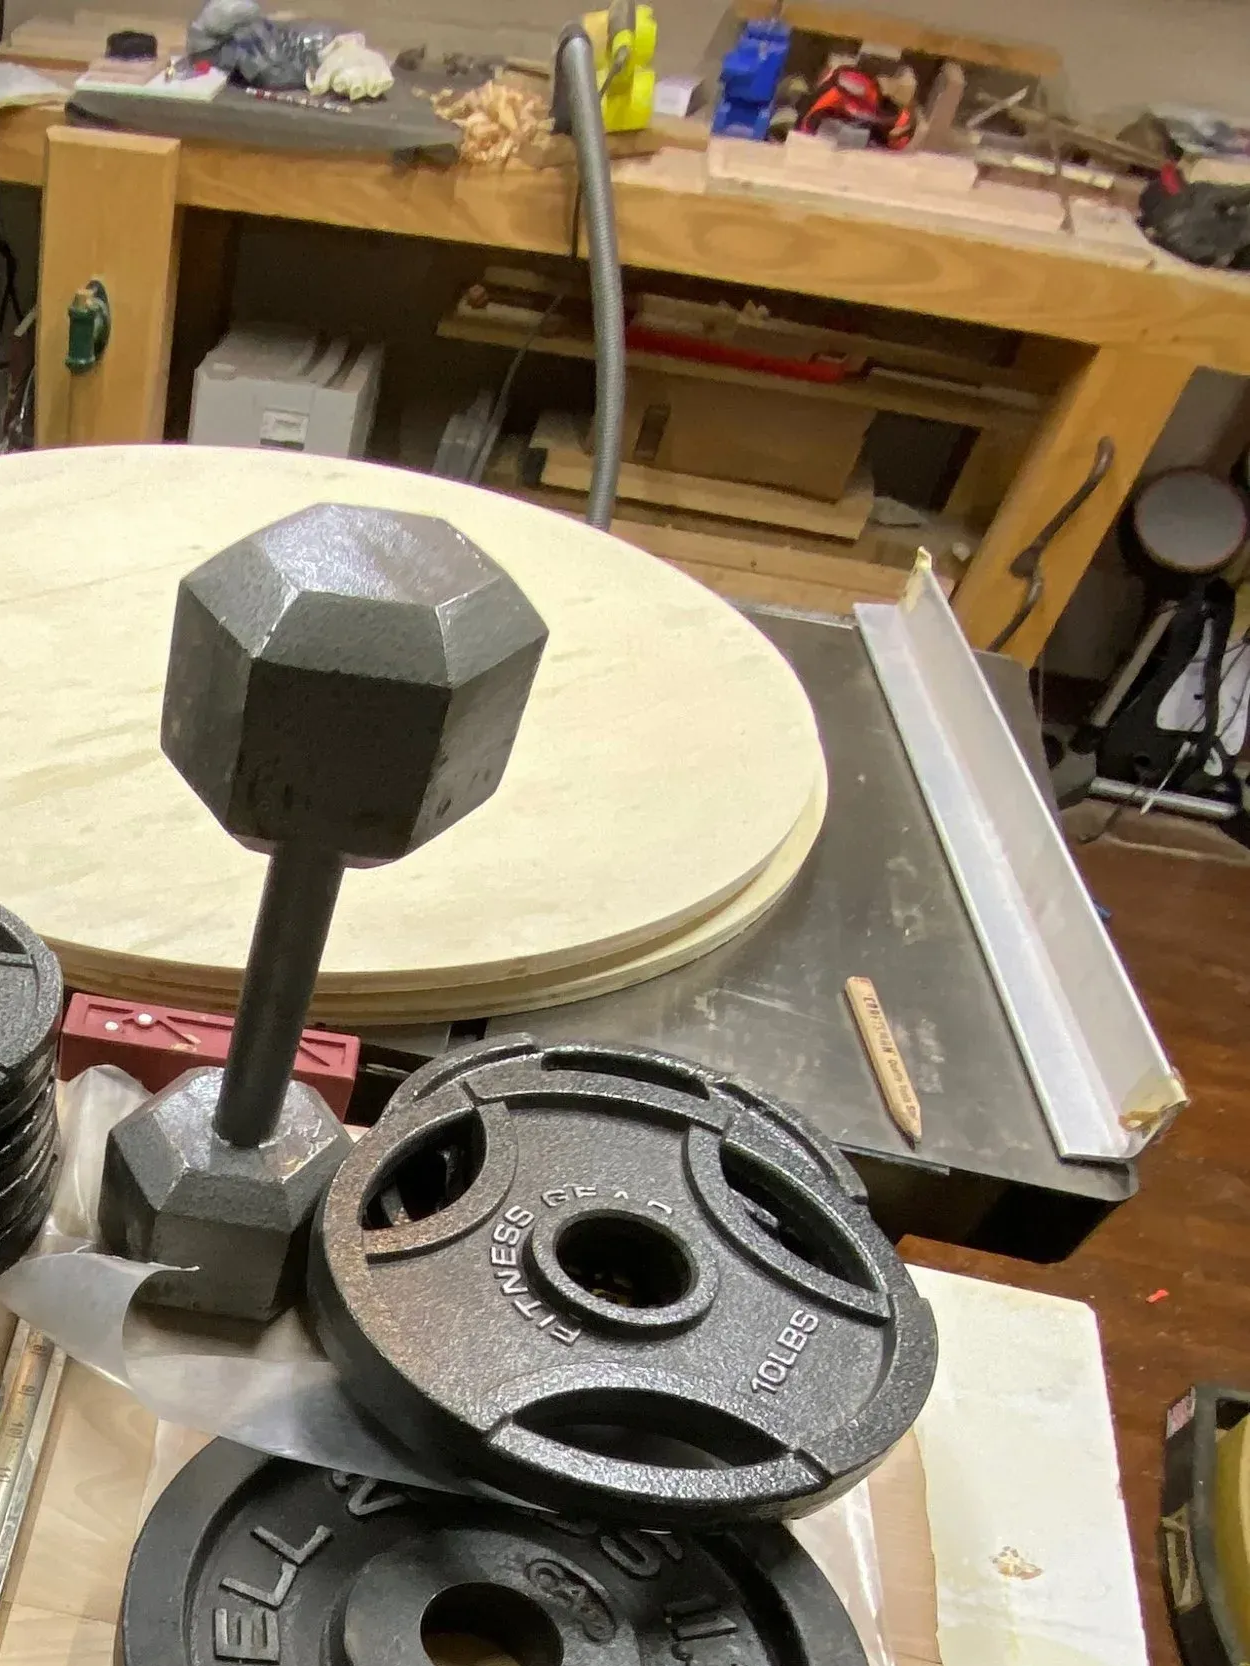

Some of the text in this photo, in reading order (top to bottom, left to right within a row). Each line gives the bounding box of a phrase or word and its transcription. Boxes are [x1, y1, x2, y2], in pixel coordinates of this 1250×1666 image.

[490, 1184, 673, 1347] FITNESS GE
[750, 1309, 820, 1395] 10LBS
